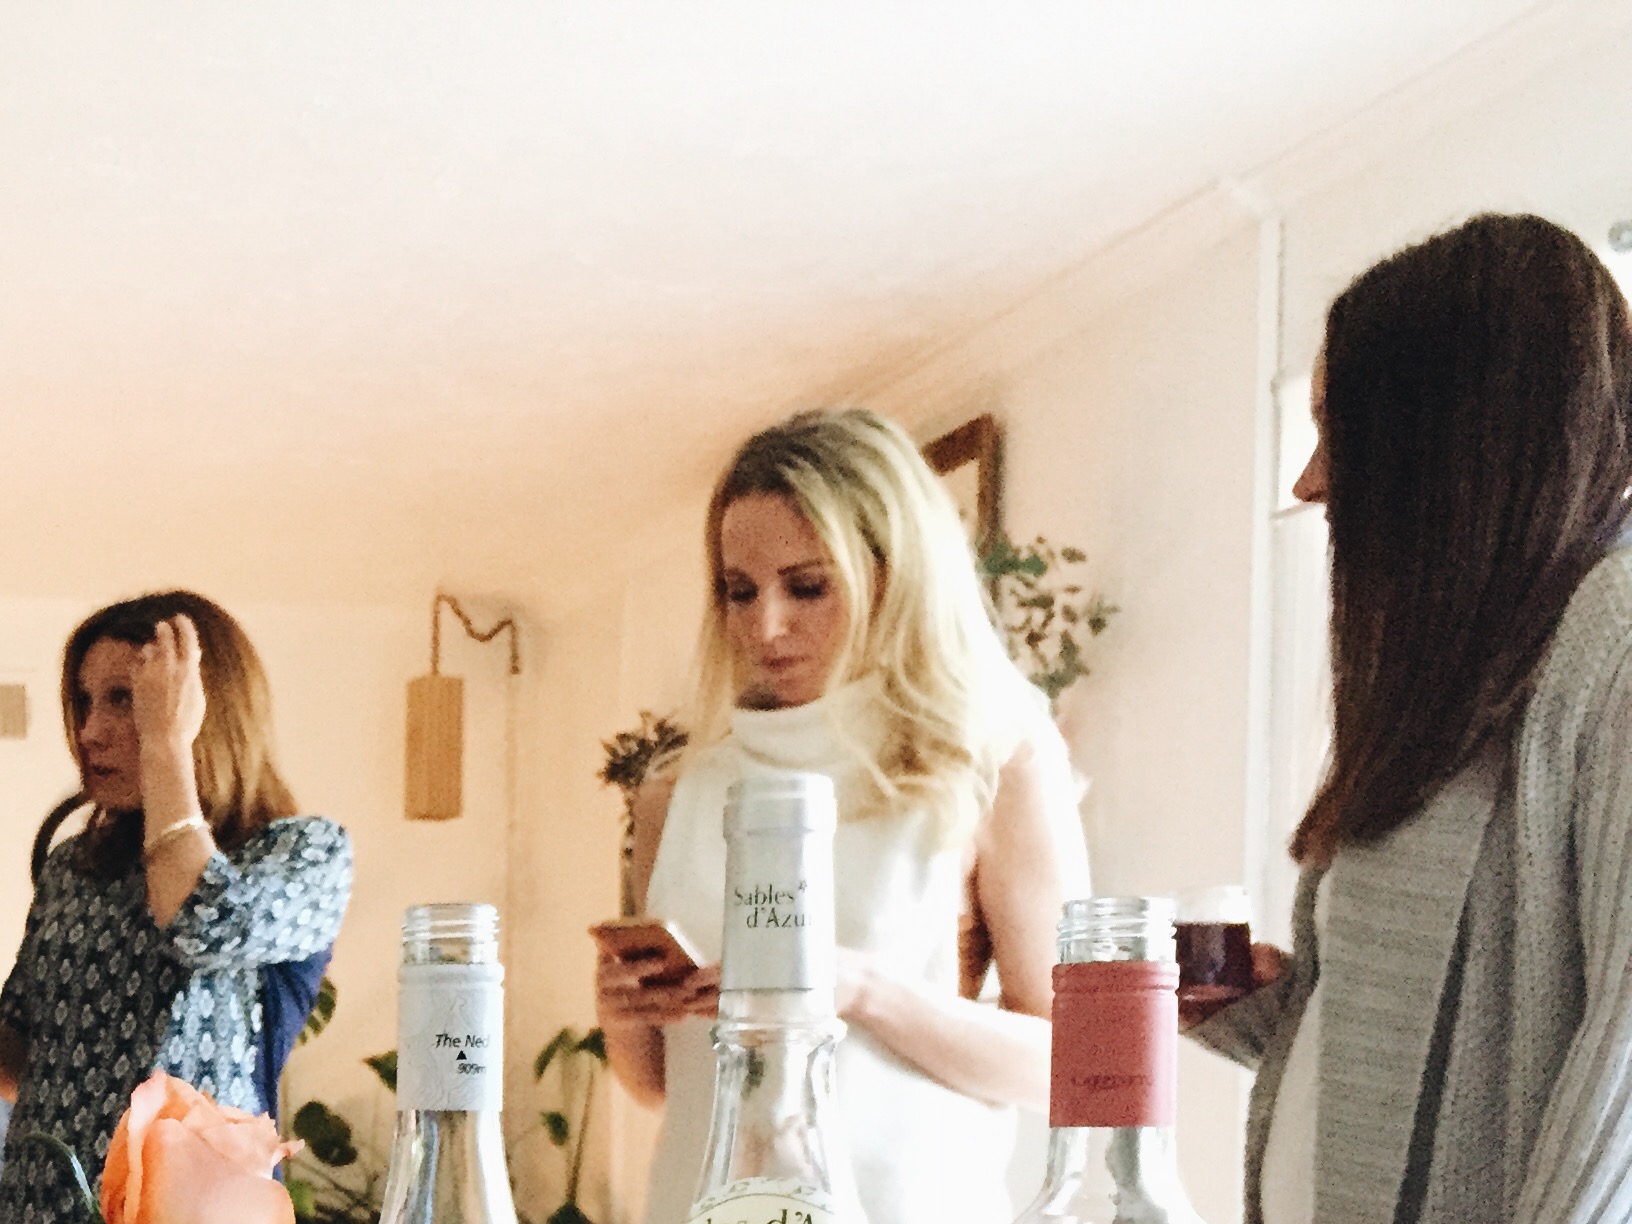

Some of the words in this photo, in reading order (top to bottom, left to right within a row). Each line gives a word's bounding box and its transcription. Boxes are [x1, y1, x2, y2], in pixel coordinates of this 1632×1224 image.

[733, 883, 795, 906] Sables
[746, 907, 812, 929] d'Azu
[435, 1033, 462, 1049] The
[464, 1034, 491, 1048] Ned
